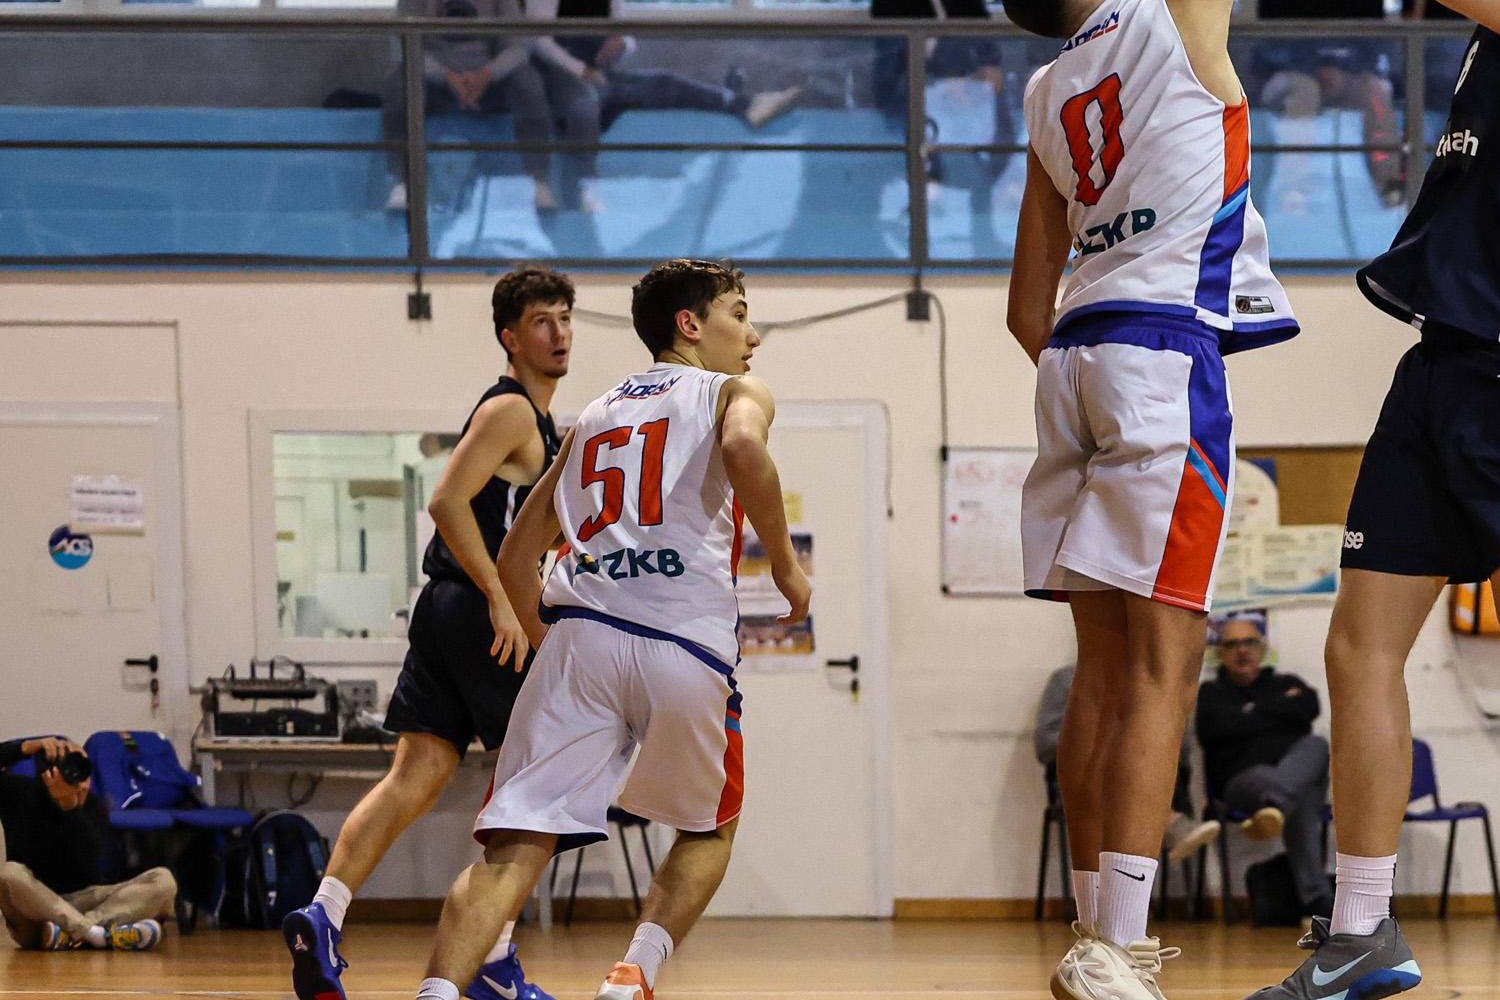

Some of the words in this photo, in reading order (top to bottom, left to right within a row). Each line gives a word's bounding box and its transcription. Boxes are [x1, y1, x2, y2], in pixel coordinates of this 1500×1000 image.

[1060, 72, 1126, 208] 0
[577, 418, 670, 543] 51
[603, 548, 686, 581] ZKB
